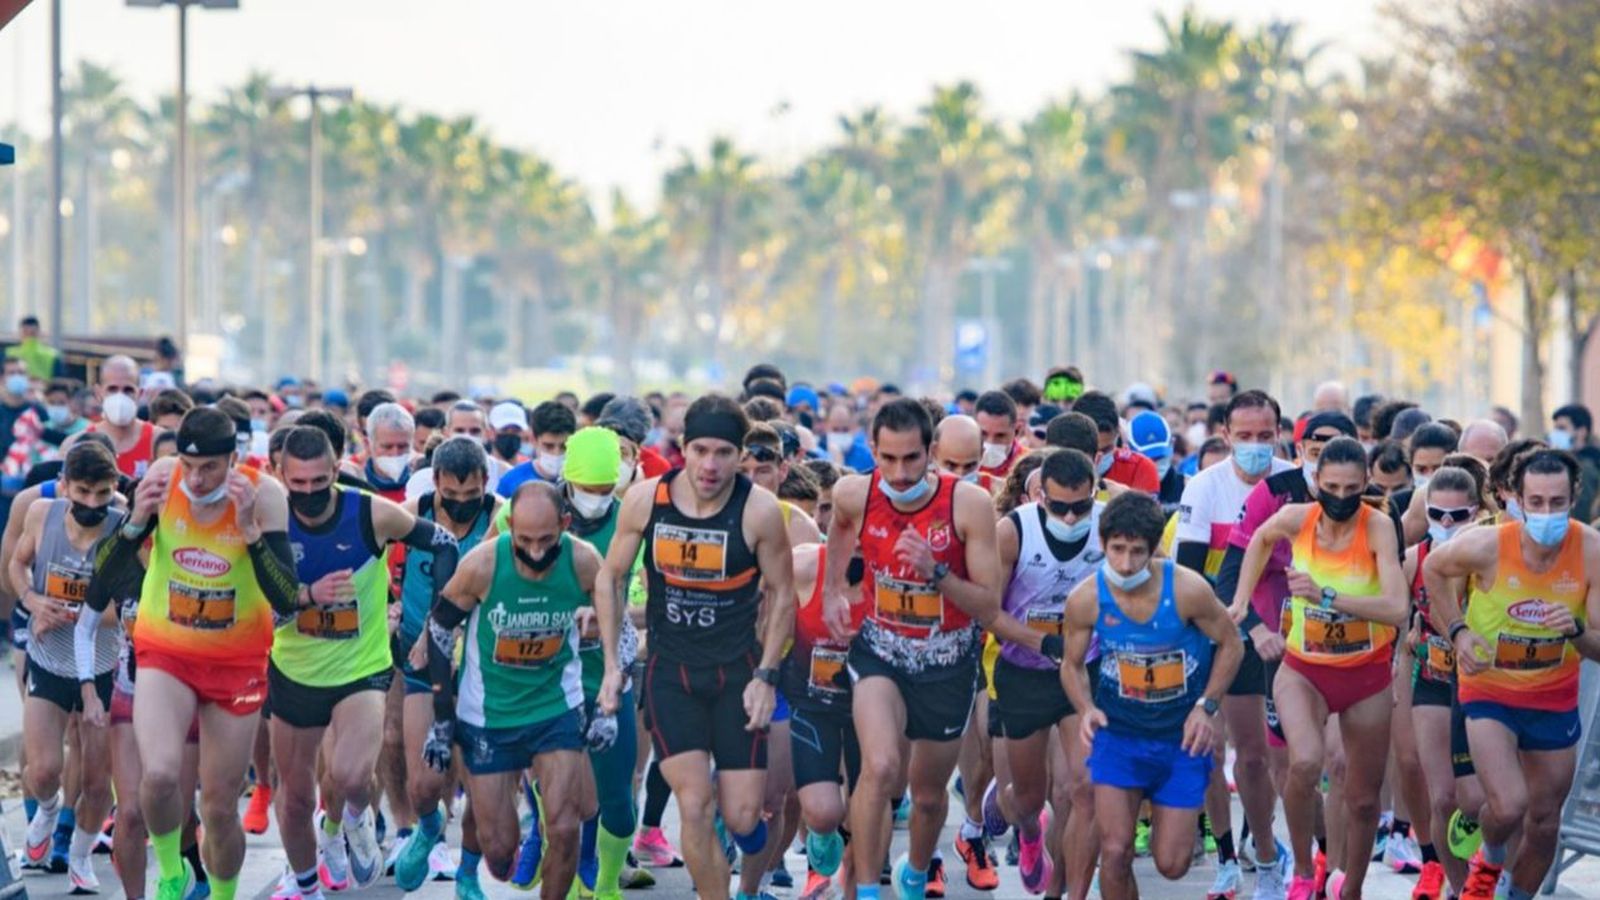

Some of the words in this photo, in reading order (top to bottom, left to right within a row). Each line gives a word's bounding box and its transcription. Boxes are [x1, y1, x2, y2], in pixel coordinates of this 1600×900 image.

[680, 543, 697, 560] 14
[178, 551, 227, 572] Serrano
[199, 600, 205, 614] 7
[900, 594, 914, 609] 11
[319, 610, 335, 626] 19
[1324, 623, 1345, 640] 23
[518, 641, 544, 656] 172
[1144, 667, 1155, 683] 4
